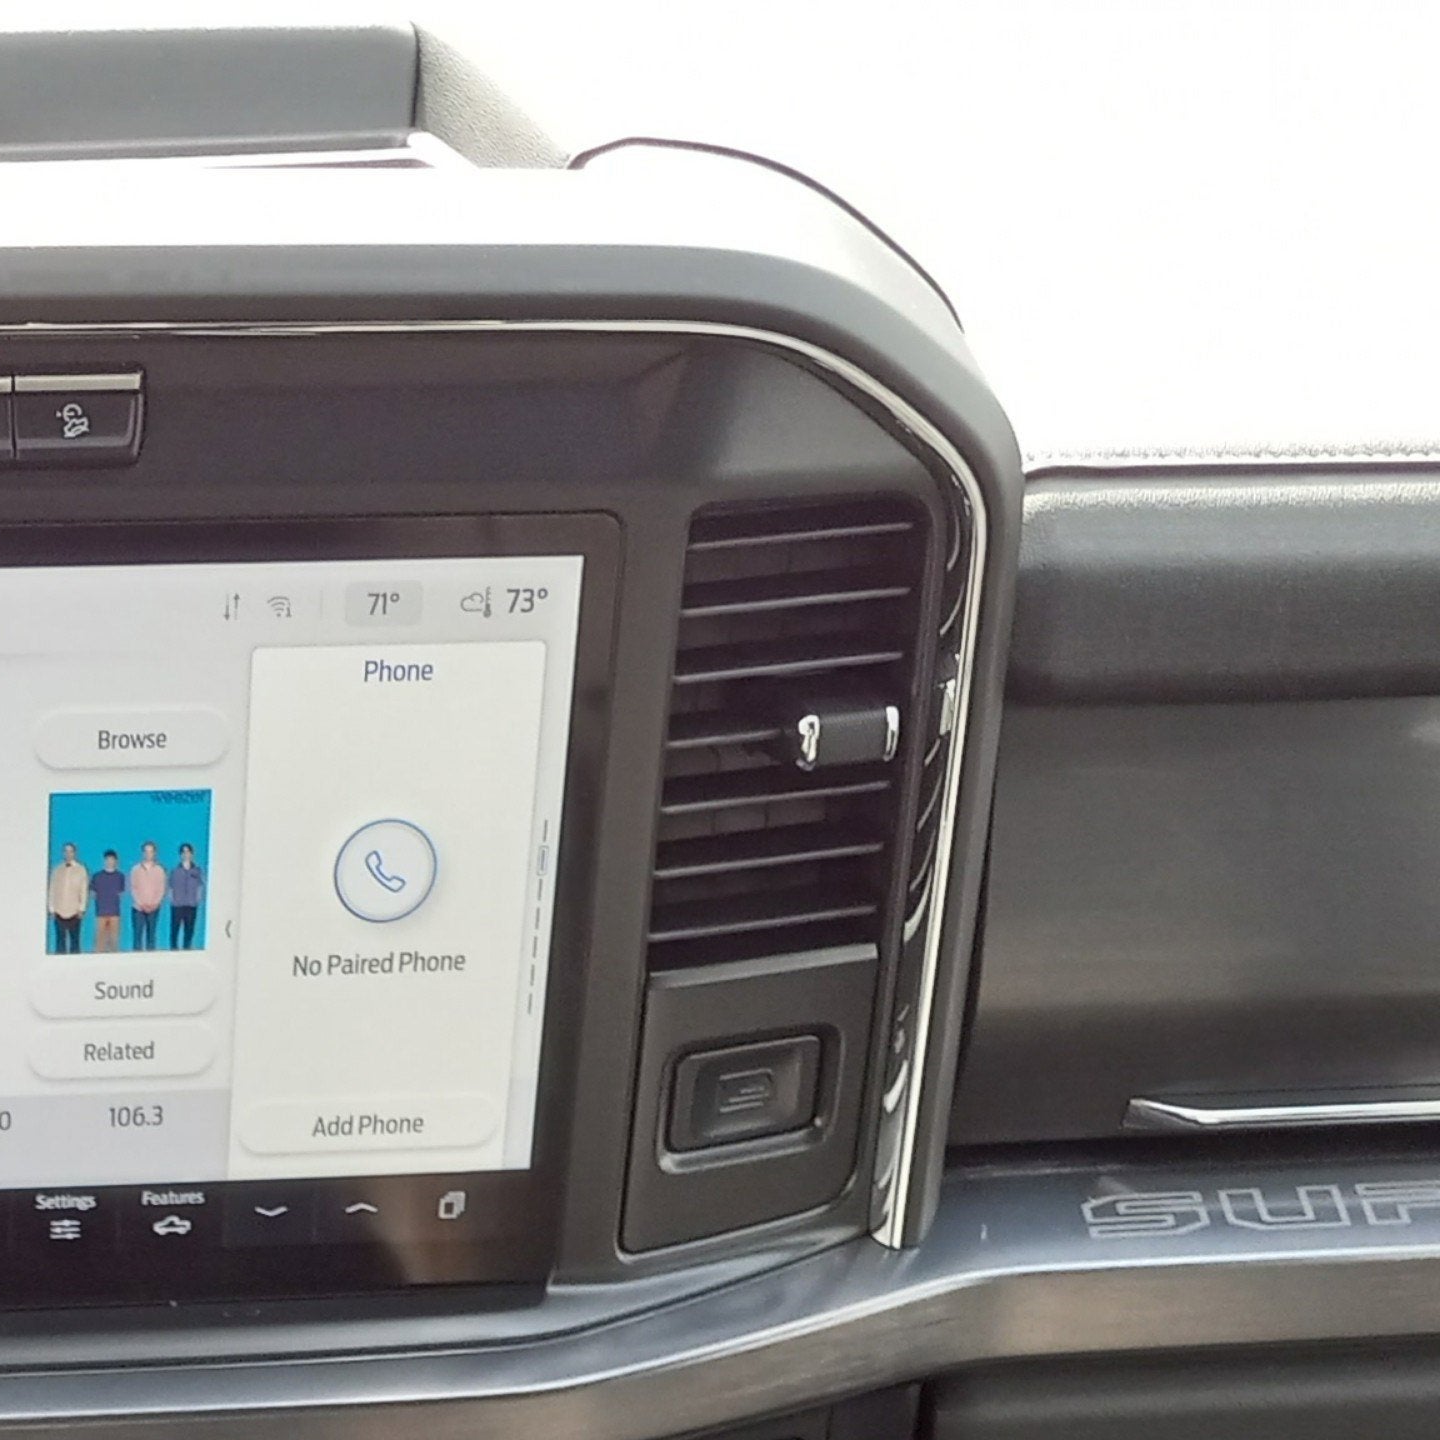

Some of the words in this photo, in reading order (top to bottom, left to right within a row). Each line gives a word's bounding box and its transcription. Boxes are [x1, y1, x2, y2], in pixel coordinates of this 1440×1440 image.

[505, 587, 549, 616] 73°
[362, 659, 435, 685] Phone
[96, 728, 168, 752] Browse
[292, 955, 322, 978] No
[324, 952, 395, 976] Paired
[398, 950, 467, 974] Phone
[94, 979, 154, 1000] Sound
[83, 1040, 155, 1062] Related
[108, 1106, 164, 1128] 106.3
[311, 1115, 354, 1137] Add
[357, 1113, 425, 1136] Phone
[35, 1192, 97, 1212] Settings
[141, 1189, 205, 1206] Features
